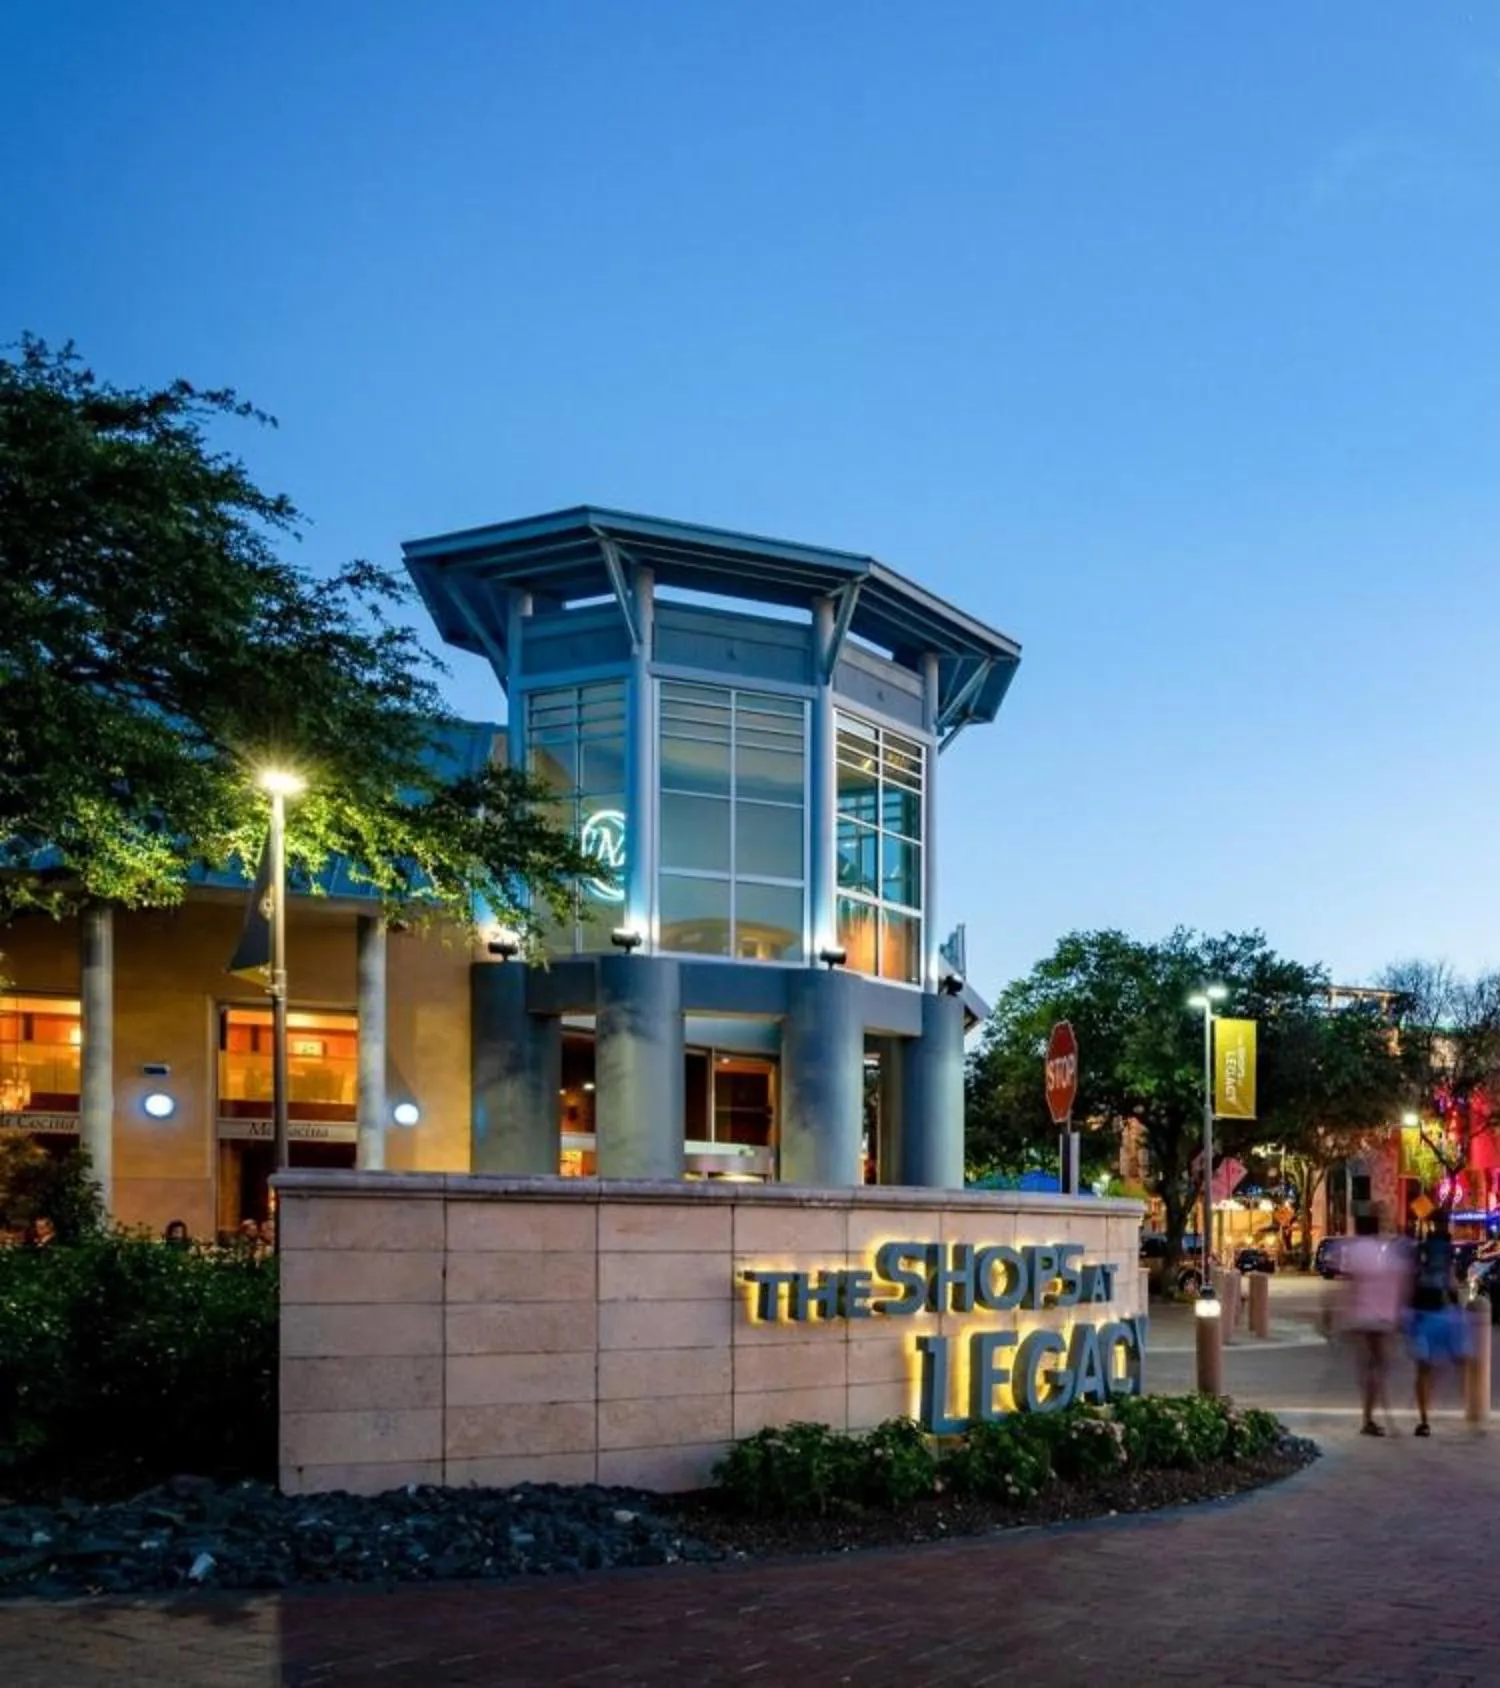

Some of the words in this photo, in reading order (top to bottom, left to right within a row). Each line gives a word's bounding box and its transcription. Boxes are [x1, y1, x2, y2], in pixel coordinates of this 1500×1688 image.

[1046, 1053, 1076, 1092] STOP
[281, 1123, 329, 1138] ocina
[743, 1270, 873, 1322] THE
[873, 1241, 1085, 1316] SHOPS
[1078, 1263, 1119, 1303] AT
[915, 1312, 1150, 1437] LEGACY
